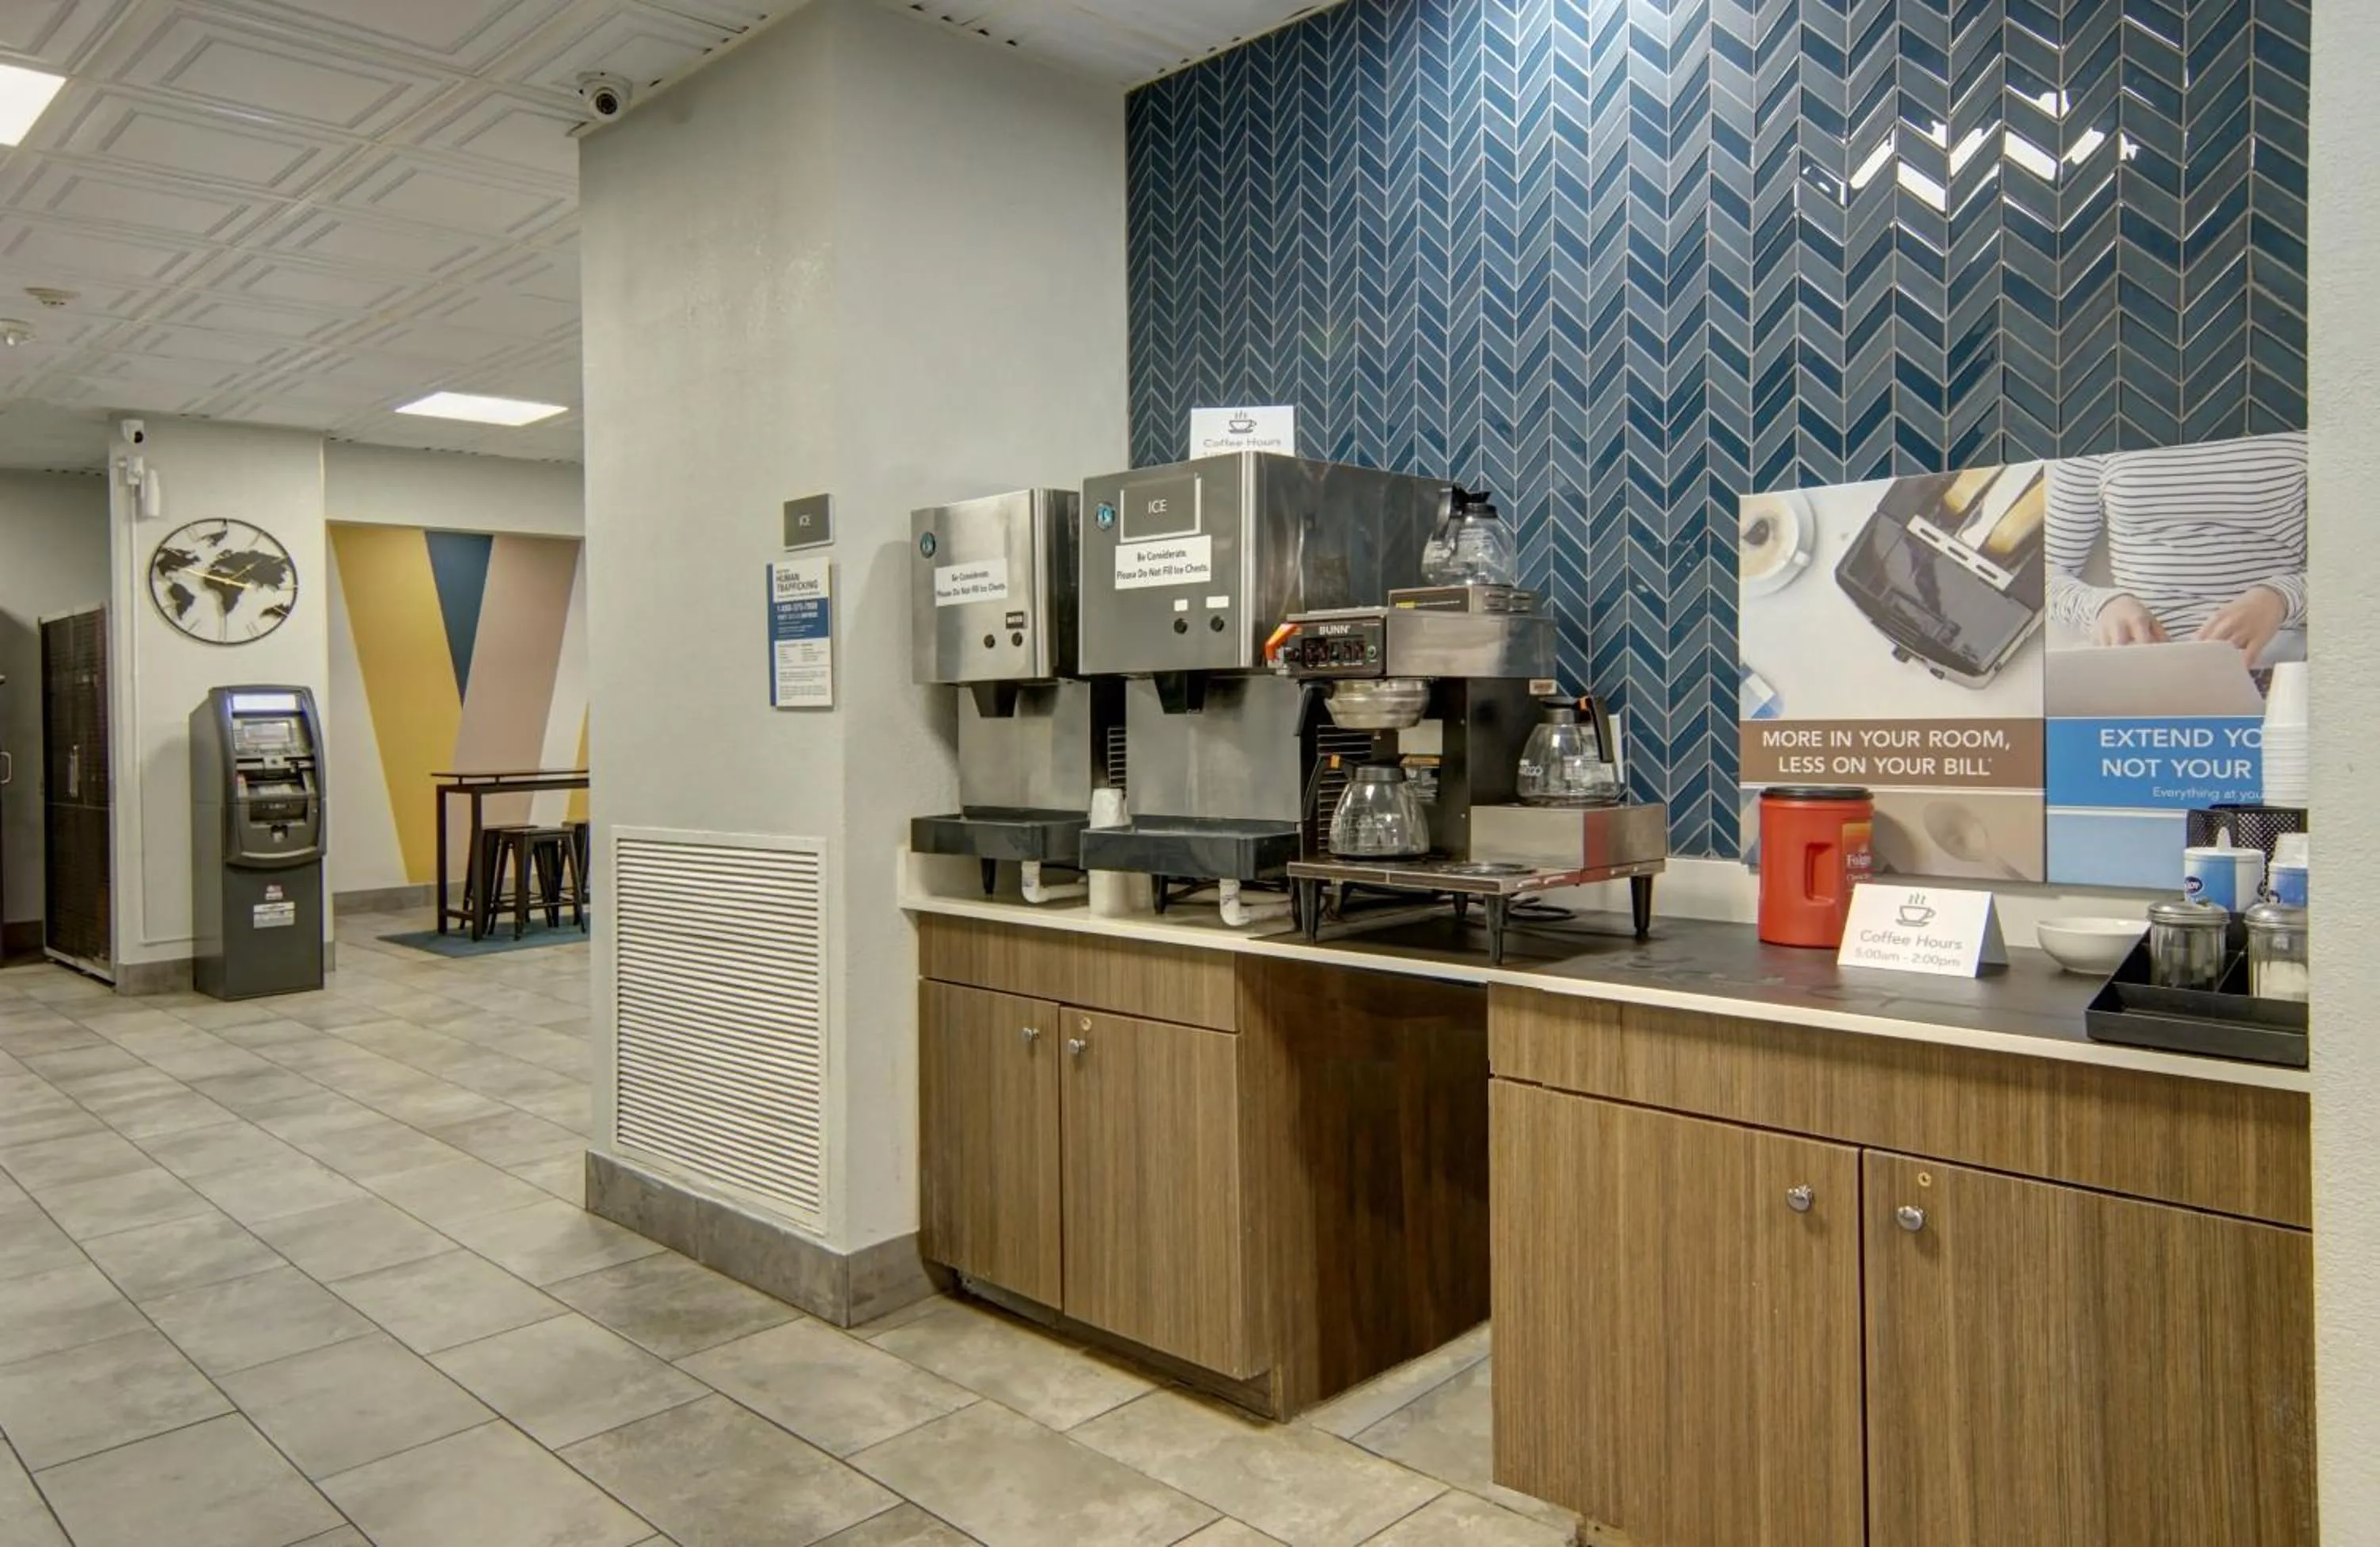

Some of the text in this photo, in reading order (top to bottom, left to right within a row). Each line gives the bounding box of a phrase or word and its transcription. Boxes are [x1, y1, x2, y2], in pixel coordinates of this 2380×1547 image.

[1203, 437, 1281, 447] Coffee Hours
[1148, 499, 1167, 514] ICE
[1138, 569, 1147, 578] Do
[1149, 567, 1161, 576] Not
[1163, 565, 1173, 574] Fill
[1319, 624, 1349, 635] BUNN
[1762, 730, 2011, 750] MORE IN YOUR ROOM,
[2100, 728, 2262, 748] EXTEND YO
[1778, 756, 1825, 774] LESS
[1833, 756, 1867, 774] ON
[1873, 757, 1936, 775] YOUR
[2102, 758, 2252, 779] NOT YOUR
[2152, 785, 2261, 801] Everything at you
[1860, 930, 1964, 950] Coffee Hours
[1911, 953, 1961, 967] 2:00pm
